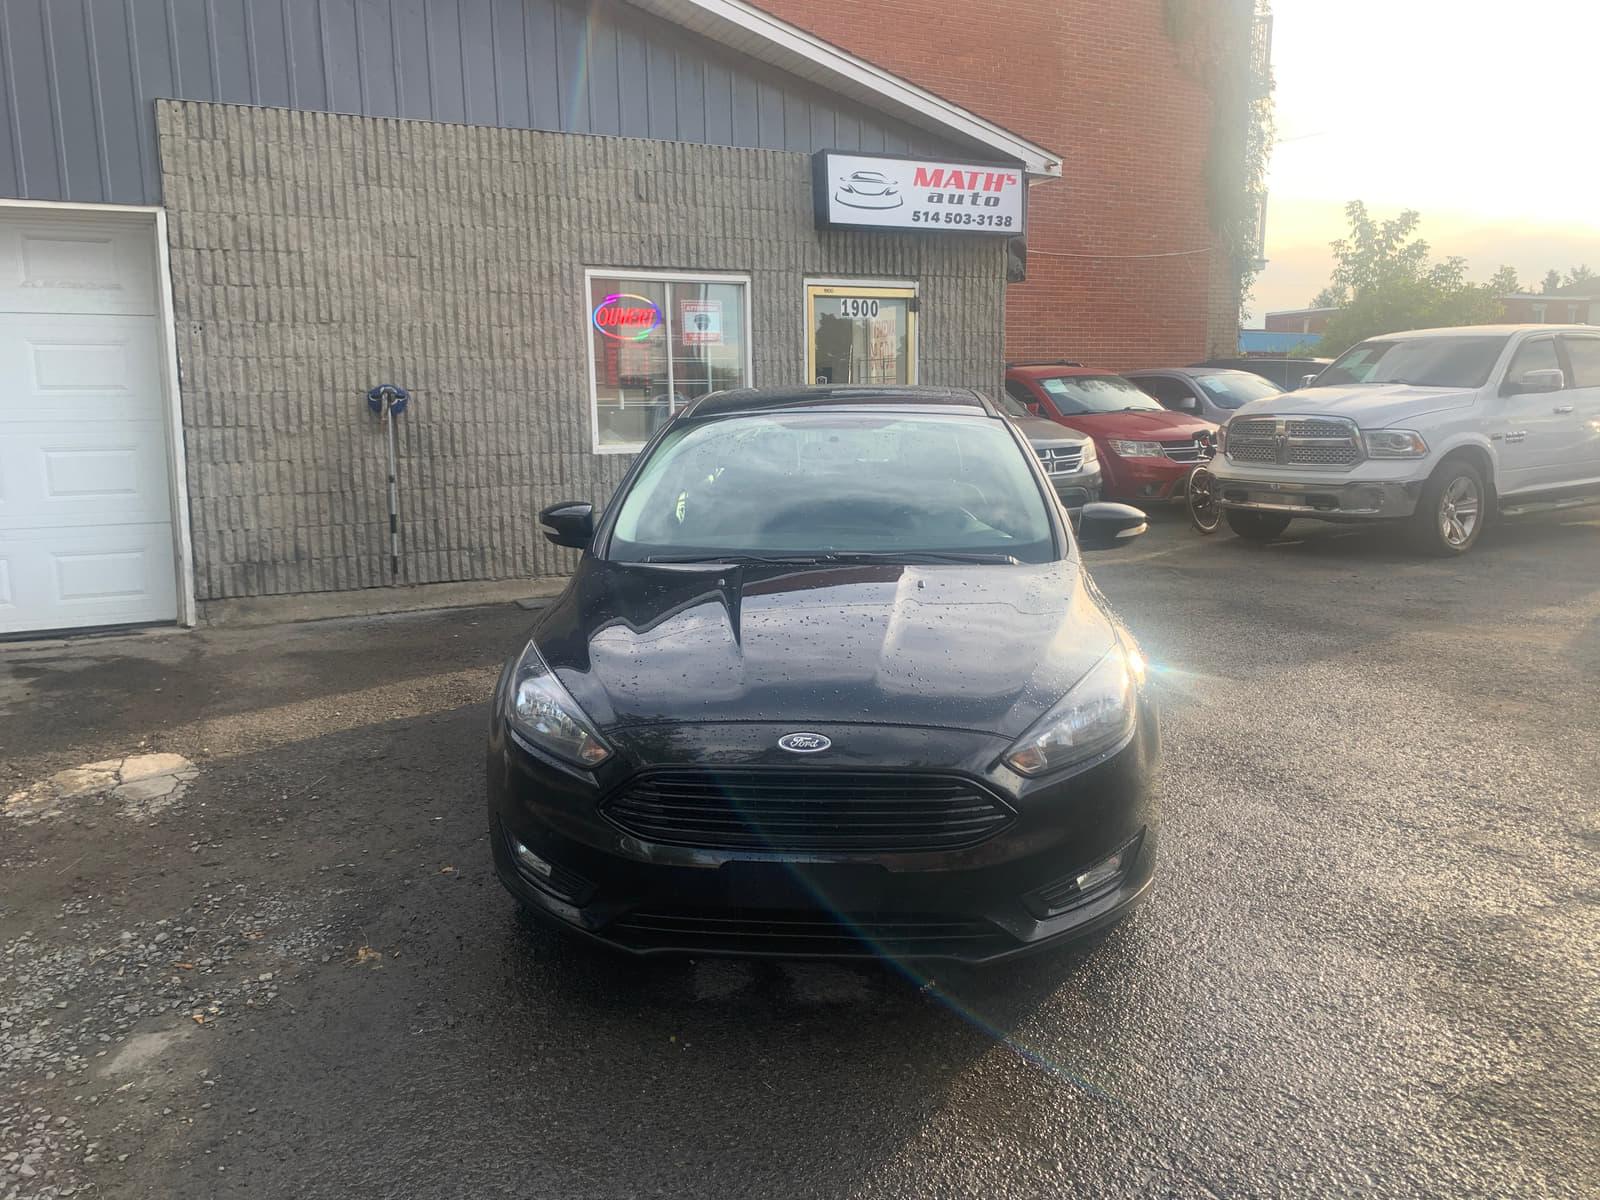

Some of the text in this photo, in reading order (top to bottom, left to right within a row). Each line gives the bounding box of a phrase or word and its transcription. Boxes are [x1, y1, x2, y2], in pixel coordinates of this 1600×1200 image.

[927, 192, 1000, 207] auto
[912, 211, 1012, 227] 514 503-3138
[841, 299, 879, 317] 1900
[597, 307, 656, 328] OUVERT
[790, 737, 819, 748] Ford
